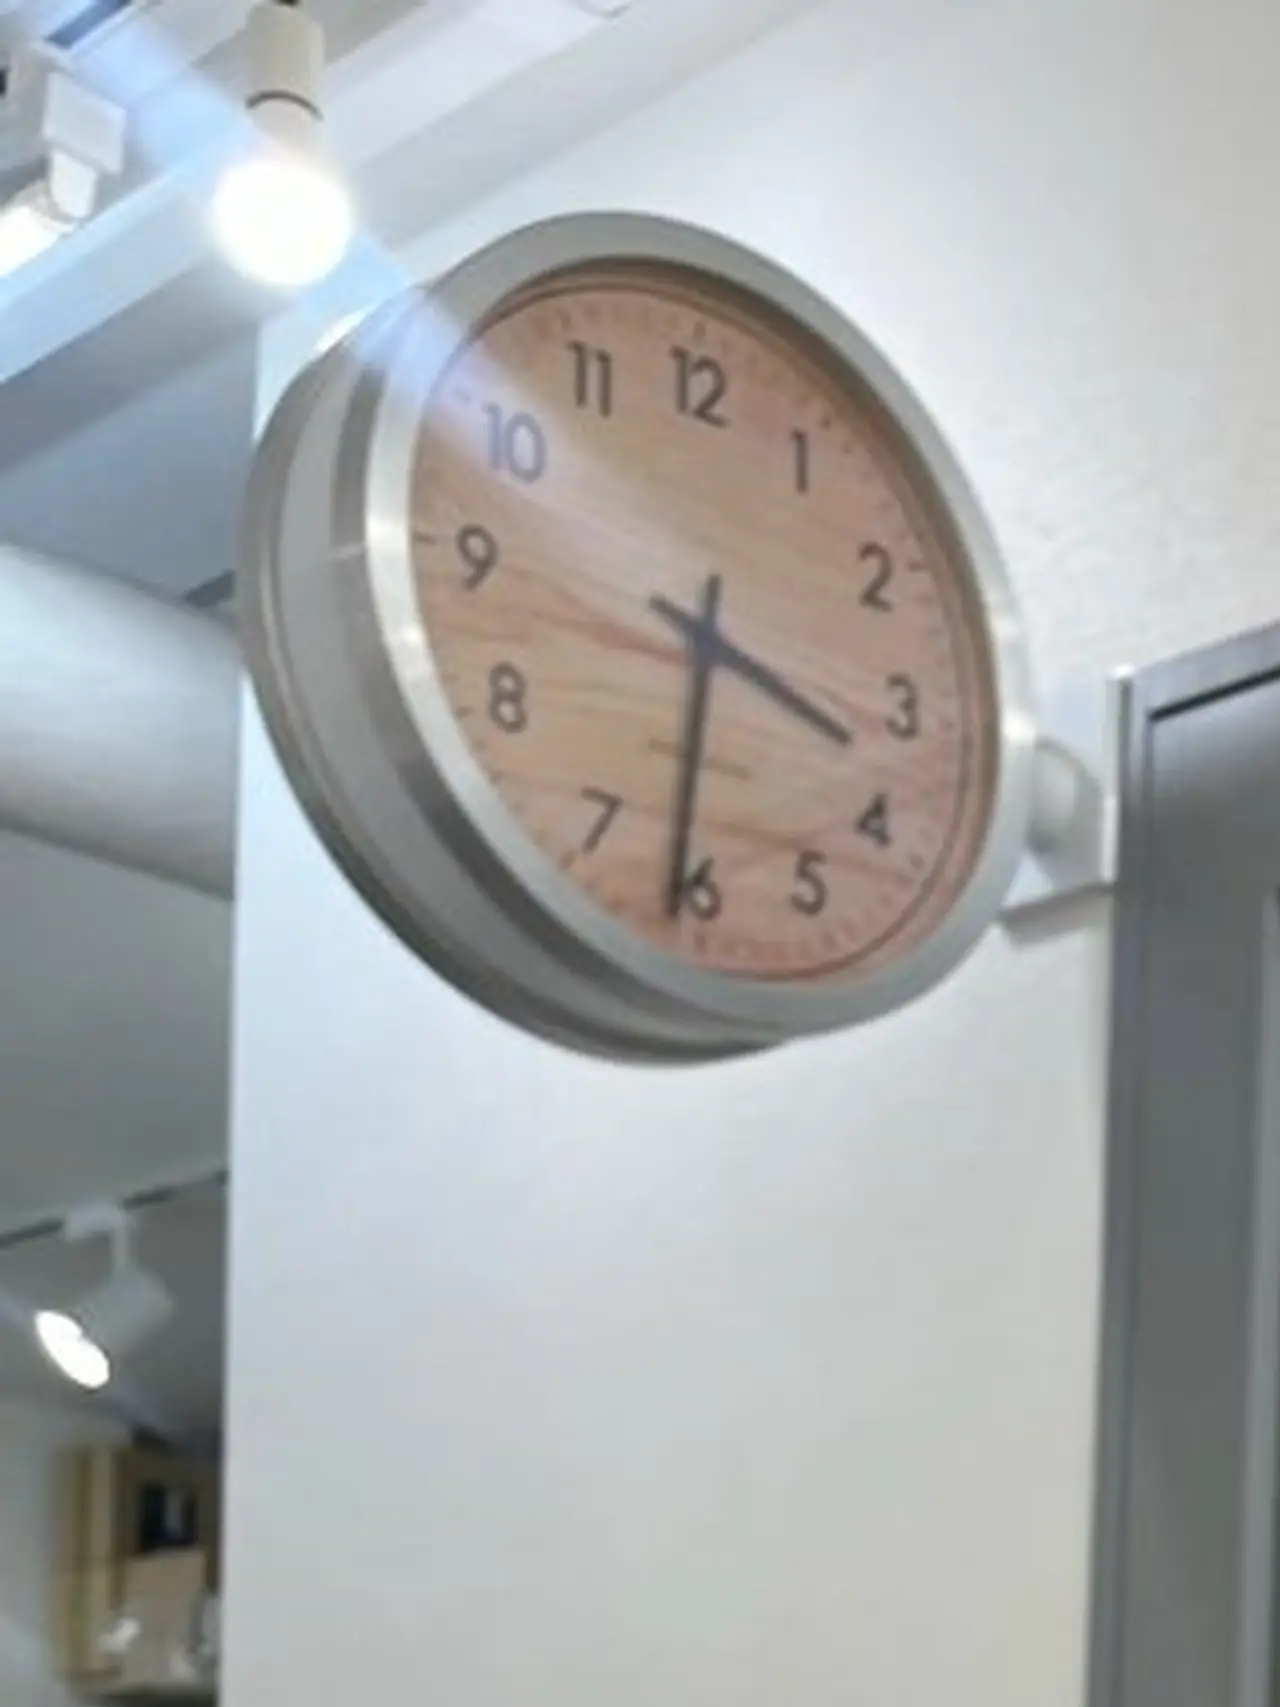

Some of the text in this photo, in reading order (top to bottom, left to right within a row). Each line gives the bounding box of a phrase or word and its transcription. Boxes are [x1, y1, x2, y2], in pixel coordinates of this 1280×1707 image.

[568, 341, 612, 418] 11
[671, 346, 730, 427] 12
[482, 404, 548, 484] 10
[791, 430, 811, 494] 1
[455, 525, 499, 591] 9
[859, 543, 894, 612] 2
[488, 662, 528, 734] 8
[886, 676, 921, 741] 3
[580, 786, 624, 853] 7
[857, 793, 892, 846] 4
[682, 861, 724, 922] 6
[791, 852, 829, 917] 5
